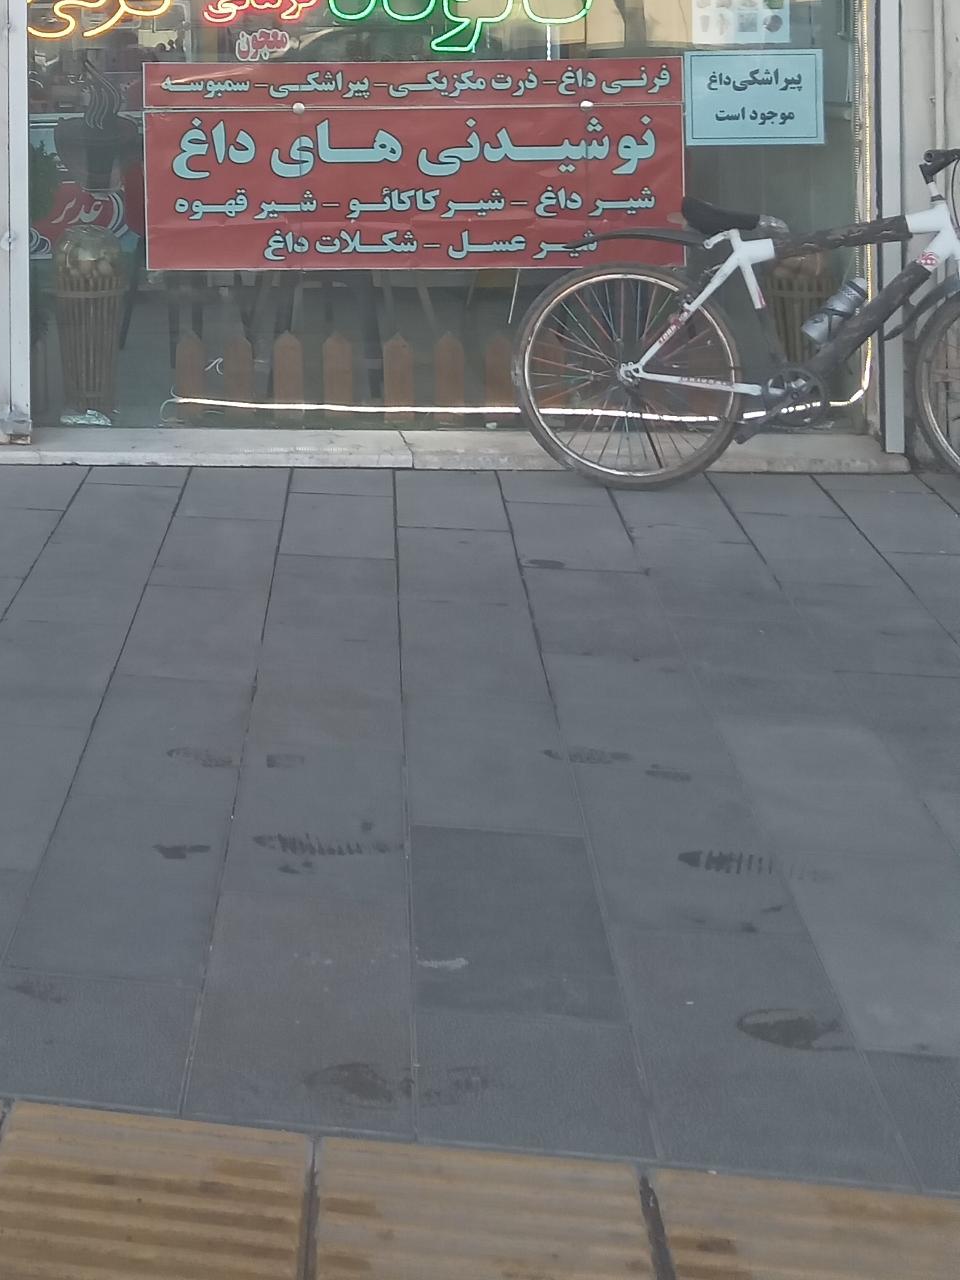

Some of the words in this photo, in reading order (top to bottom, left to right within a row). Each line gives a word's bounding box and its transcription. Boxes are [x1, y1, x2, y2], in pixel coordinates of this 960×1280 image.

[160, 75, 250, 99] سمبوسه
[491, 67, 538, 97] ذرت
[601, 64, 672, 94] فرنی
[707, 72, 732, 90] داغ
[732, 68, 802, 92] پیراشکی
[715, 106, 746, 121] است
[749, 108, 795, 125] موجود
[172, 117, 257, 179] داغ
[270, 119, 403, 178] های
[417, 115, 656, 177] نوشیدنی
[174, 188, 249, 221] قهوه
[253, 190, 318, 220] شیر
[346, 187, 441, 219] کاکائو
[440, 188, 506, 218] شیر
[535, 185, 583, 218] داغ
[588, 187, 656, 217] شیر
[263, 230, 310, 261] داغ
[315, 230, 418, 254] شکلات
[447, 229, 527, 259] عسل
[532, 229, 599, 259] شیر
